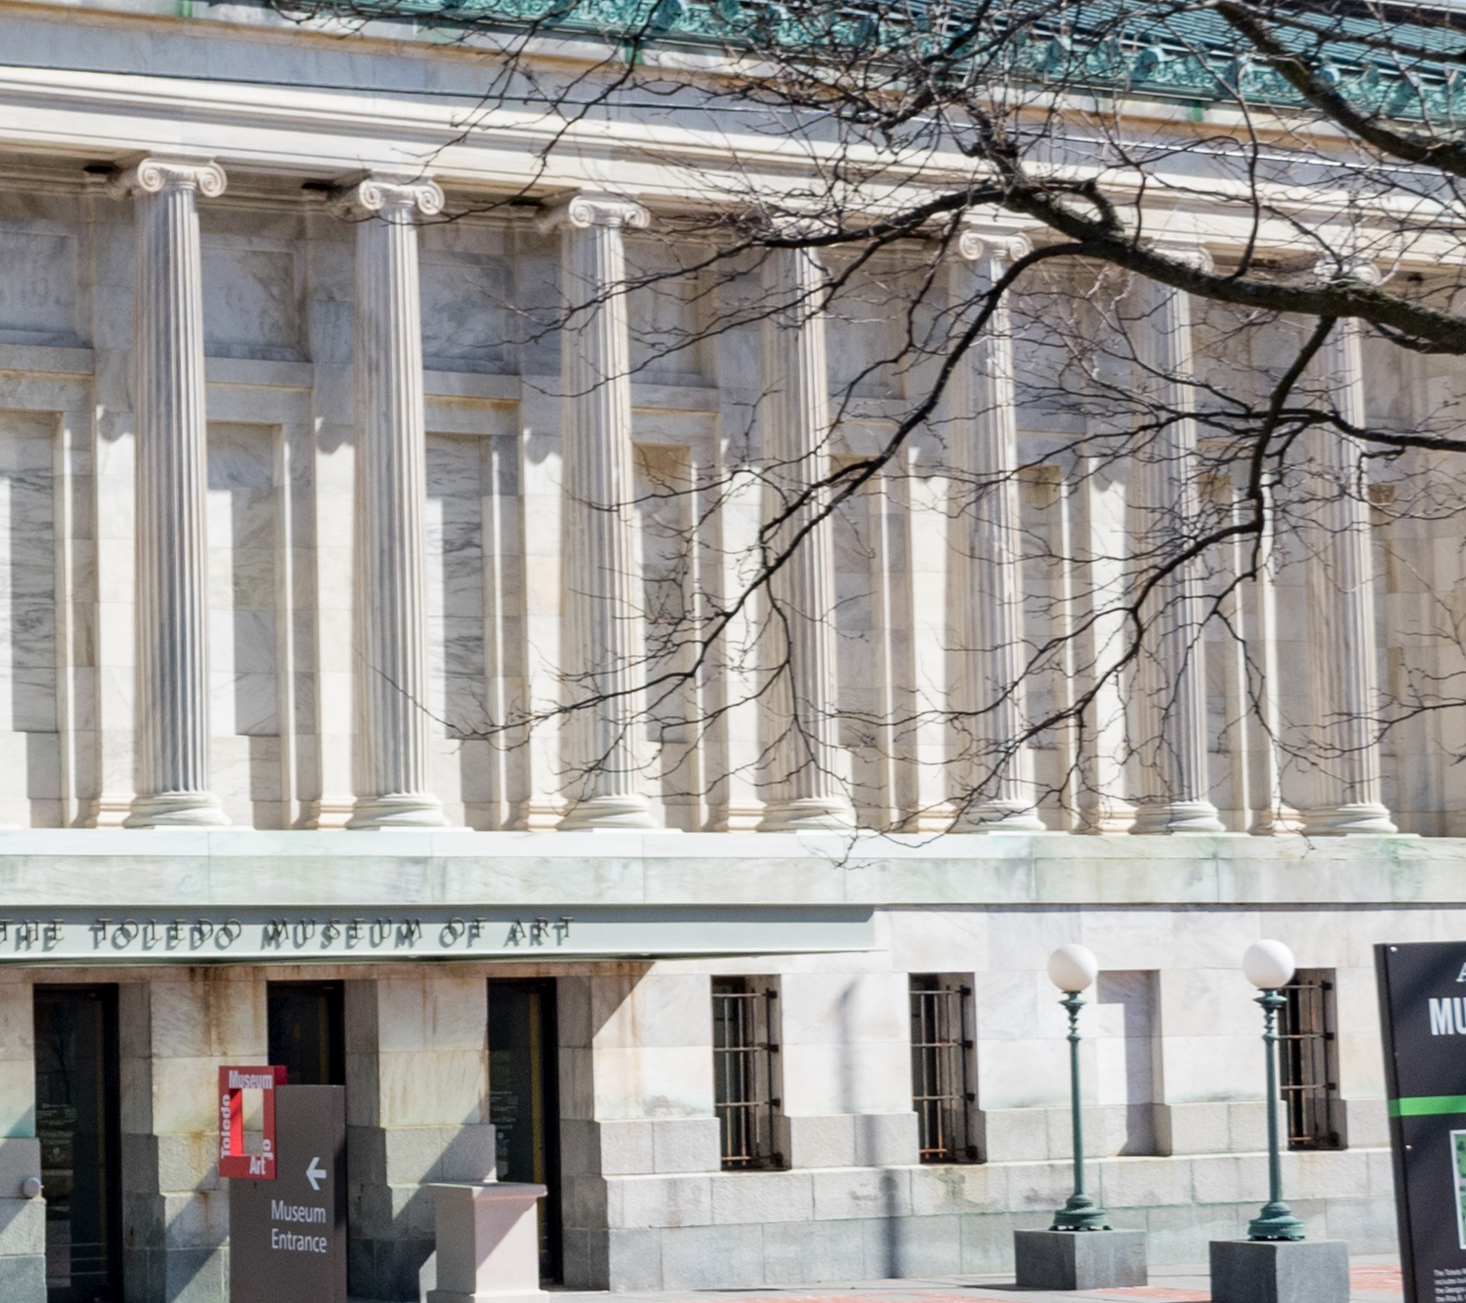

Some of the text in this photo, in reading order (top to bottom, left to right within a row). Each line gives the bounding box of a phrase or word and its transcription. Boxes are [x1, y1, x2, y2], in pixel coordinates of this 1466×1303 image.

[95, 918, 242, 943] TOLEDO
[267, 917, 423, 942] MUSEUM
[446, 916, 487, 941] OF
[511, 915, 575, 940] ART
[228, 1070, 273, 1090] Museum
[220, 1093, 231, 1159] Toledo
[262, 1138, 274, 1161] of
[249, 1155, 266, 1176] Art
[271, 1199, 326, 1224] Museum
[271, 1228, 328, 1254] Entrance
